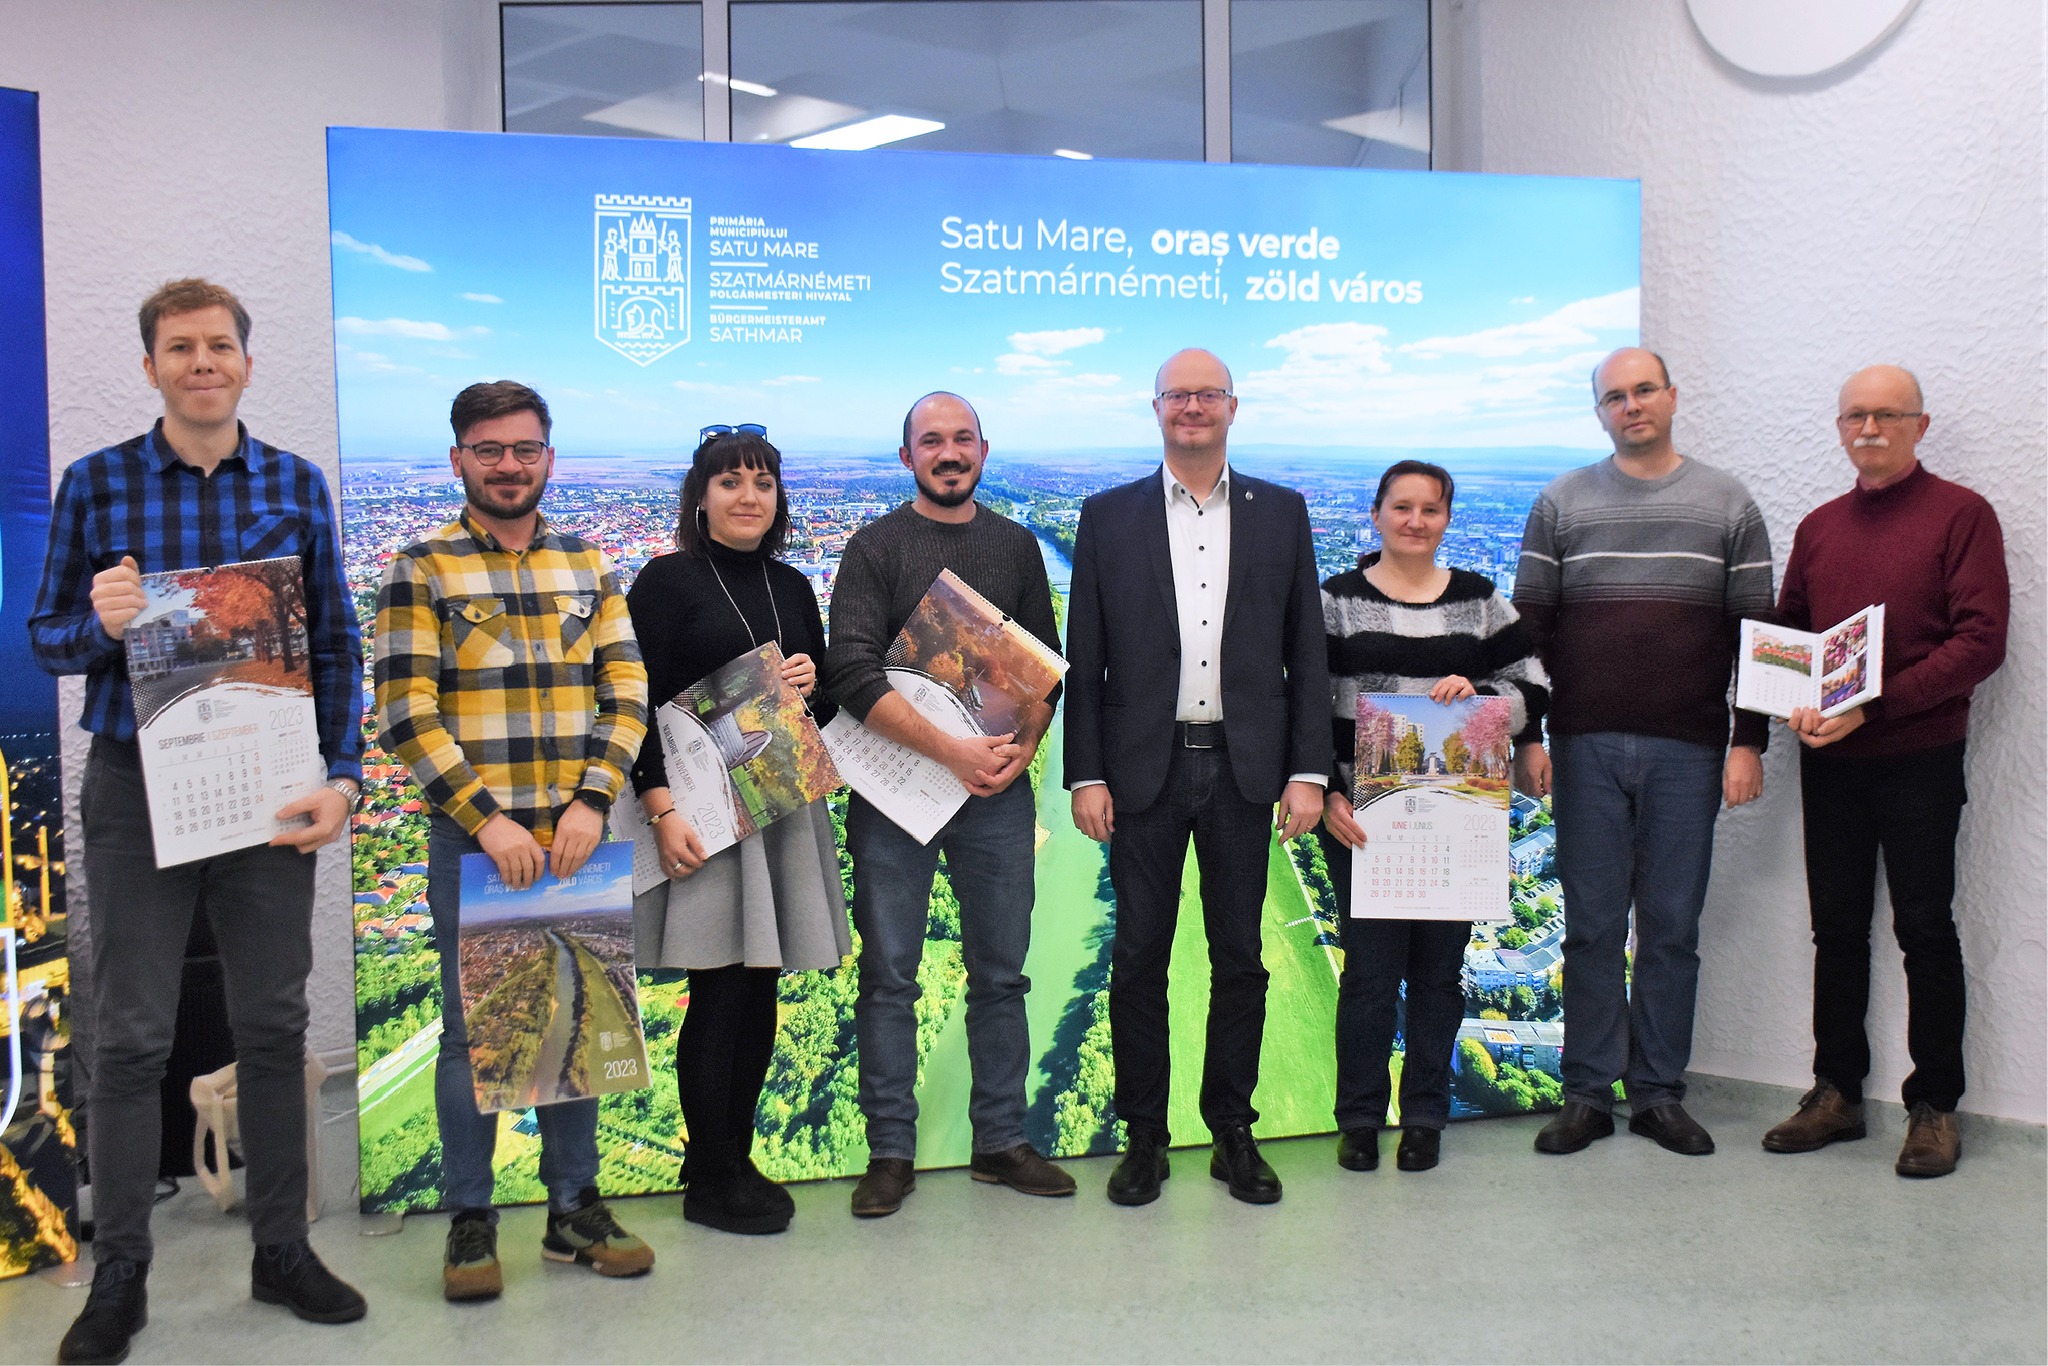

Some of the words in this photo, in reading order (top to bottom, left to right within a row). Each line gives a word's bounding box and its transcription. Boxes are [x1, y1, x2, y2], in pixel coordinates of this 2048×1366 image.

[710, 216, 765, 227] PRIMĂRIA
[710, 227, 787, 238] MUNICIPIULUI
[940, 216, 1022, 251] Satu
[1037, 219, 1134, 260] Mare,
[1151, 229, 1230, 266] oraș
[1238, 227, 1340, 260] verde
[710, 240, 757, 257] SATU
[764, 242, 818, 258] MARE
[710, 270, 871, 291] SZATMÁRNÉMETI
[940, 261, 1228, 305] Szatmárnémeti,
[1246, 269, 1320, 302] zöld
[1329, 272, 1423, 304] város
[710, 290, 802, 301] POLGÁRMESTERI
[806, 291, 852, 302] HIVATAL
[710, 314, 826, 326] BÜRGERMEISTERAMT
[710, 328, 802, 343] SATHMAR
[270, 705, 303, 730] 2023
[159, 732, 205, 750] SEPTEMBRIE
[228, 757, 232, 766] 1
[241, 754, 246, 764] 2
[254, 752, 259, 761] 3
[663, 724, 679, 756] NOIEMBRIE
[675, 759, 696, 792] NOVEMBER
[836, 755, 844, 763] 31
[843, 730, 851, 738] 16
[852, 738, 861, 746] 17
[862, 746, 870, 755] 18
[871, 754, 879, 762] 19
[879, 761, 888, 770] 20
[888, 769, 897, 778] 21
[897, 776, 906, 786] 22
[861, 729, 870, 738] 10
[879, 745, 887, 754] 12
[888, 753, 896, 761] 13
[897, 760, 904, 769] 14
[905, 768, 913, 776] 15
[834, 737, 843, 746] 23
[843, 745, 853, 755] 24
[852, 754, 862, 763] 25
[862, 762, 871, 770] 26
[871, 770, 880, 778] 27
[880, 778, 890, 786] 28
[889, 785, 899, 794] 29
[173, 782, 178, 790] 4
[187, 779, 192, 789] 5
[201, 777, 207, 786] 6
[215, 774, 220, 783] 7
[229, 771, 234, 780] 8
[173, 797, 180, 806] 11
[187, 794, 194, 803] 12
[201, 791, 208, 800] 13
[214, 789, 222, 797] 14
[229, 785, 236, 795] 15
[241, 783, 249, 792] 16
[255, 780, 262, 789] 17
[174, 811, 182, 820] 18
[201, 805, 210, 815] 20
[215, 802, 224, 812] 21
[229, 799, 237, 809] 22
[242, 797, 251, 806] 23
[255, 794, 263, 803] 24
[175, 825, 184, 835] 25
[189, 822, 198, 832] 26
[203, 819, 211, 829] 27
[217, 816, 225, 826] 28
[230, 814, 238, 823] 29
[243, 810, 252, 820] 30
[698, 803, 726, 839] 2023
[1392, 821, 1407, 829] IUNIE
[1413, 822, 1433, 830] JUNIUS
[1464, 814, 1497, 831] 2023
[1432, 856, 1438, 864] 10
[1384, 867, 1390, 875] 13
[1430, 879, 1438, 887] 24
[1395, 890, 1402, 898] 28
[1407, 890, 1414, 898] 29
[604, 1058, 638, 1079] 2023
